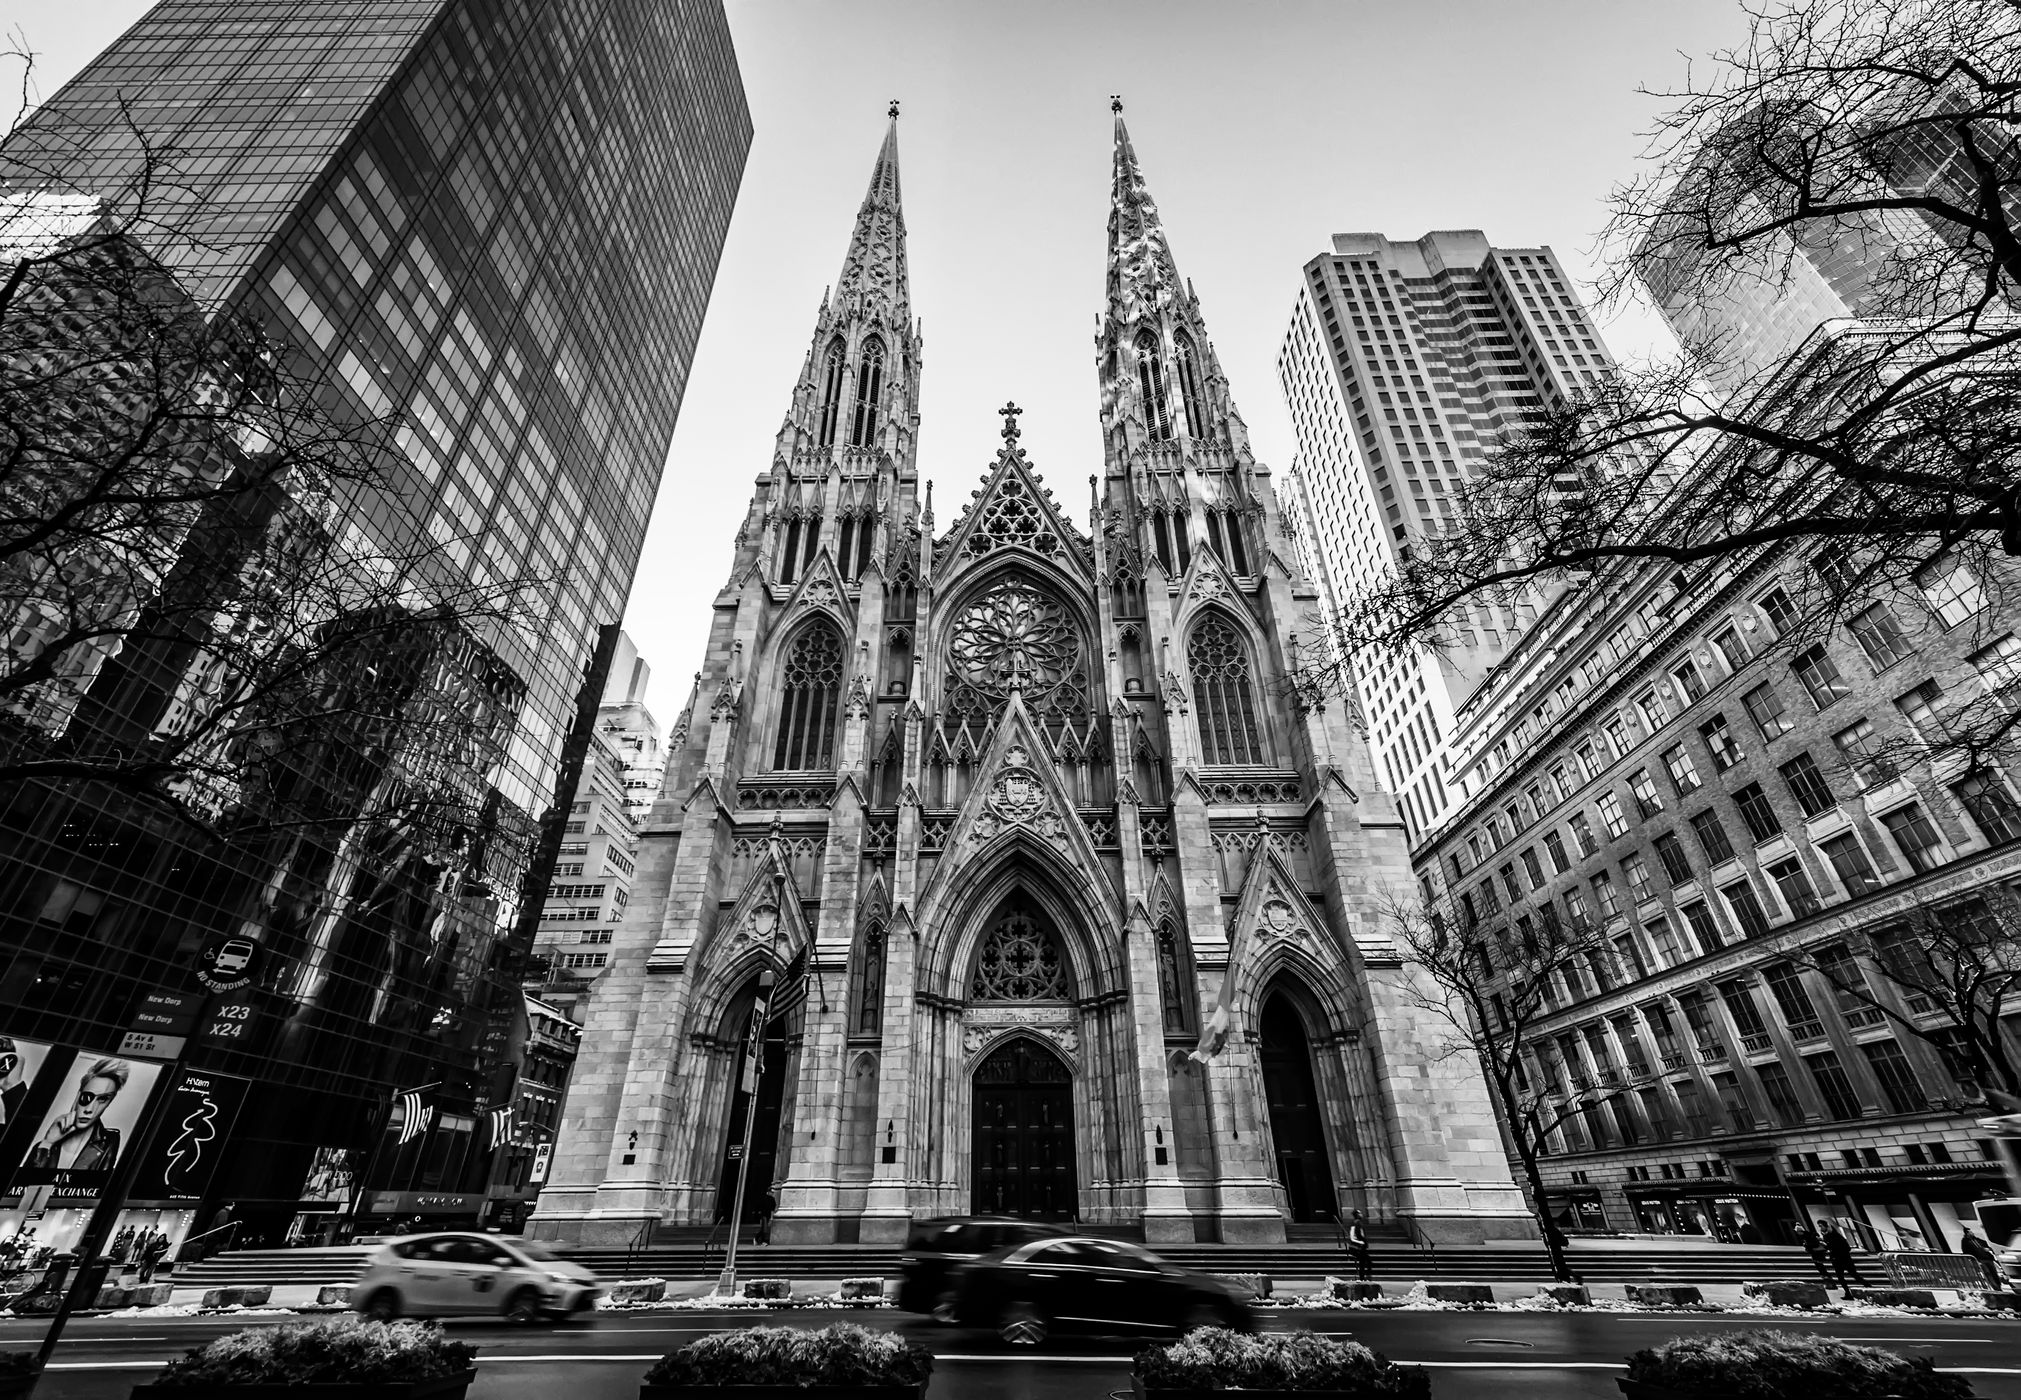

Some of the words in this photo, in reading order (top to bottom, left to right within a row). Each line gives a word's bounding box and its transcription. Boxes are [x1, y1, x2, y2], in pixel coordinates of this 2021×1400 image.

[196, 970, 209, 982] NO
[204, 976, 251, 990] STANDING
[147, 995, 164, 1003] New
[164, 996, 182, 1006] Dorp
[217, 1005, 250, 1019] X23
[138, 1013, 155, 1022] New
[155, 1015, 173, 1025] Dorp
[209, 1022, 243, 1037] X24
[134, 1034, 146, 1042] Av
[145, 1043, 156, 1051] St
[49, 1187, 100, 1197] EXCHANGE
